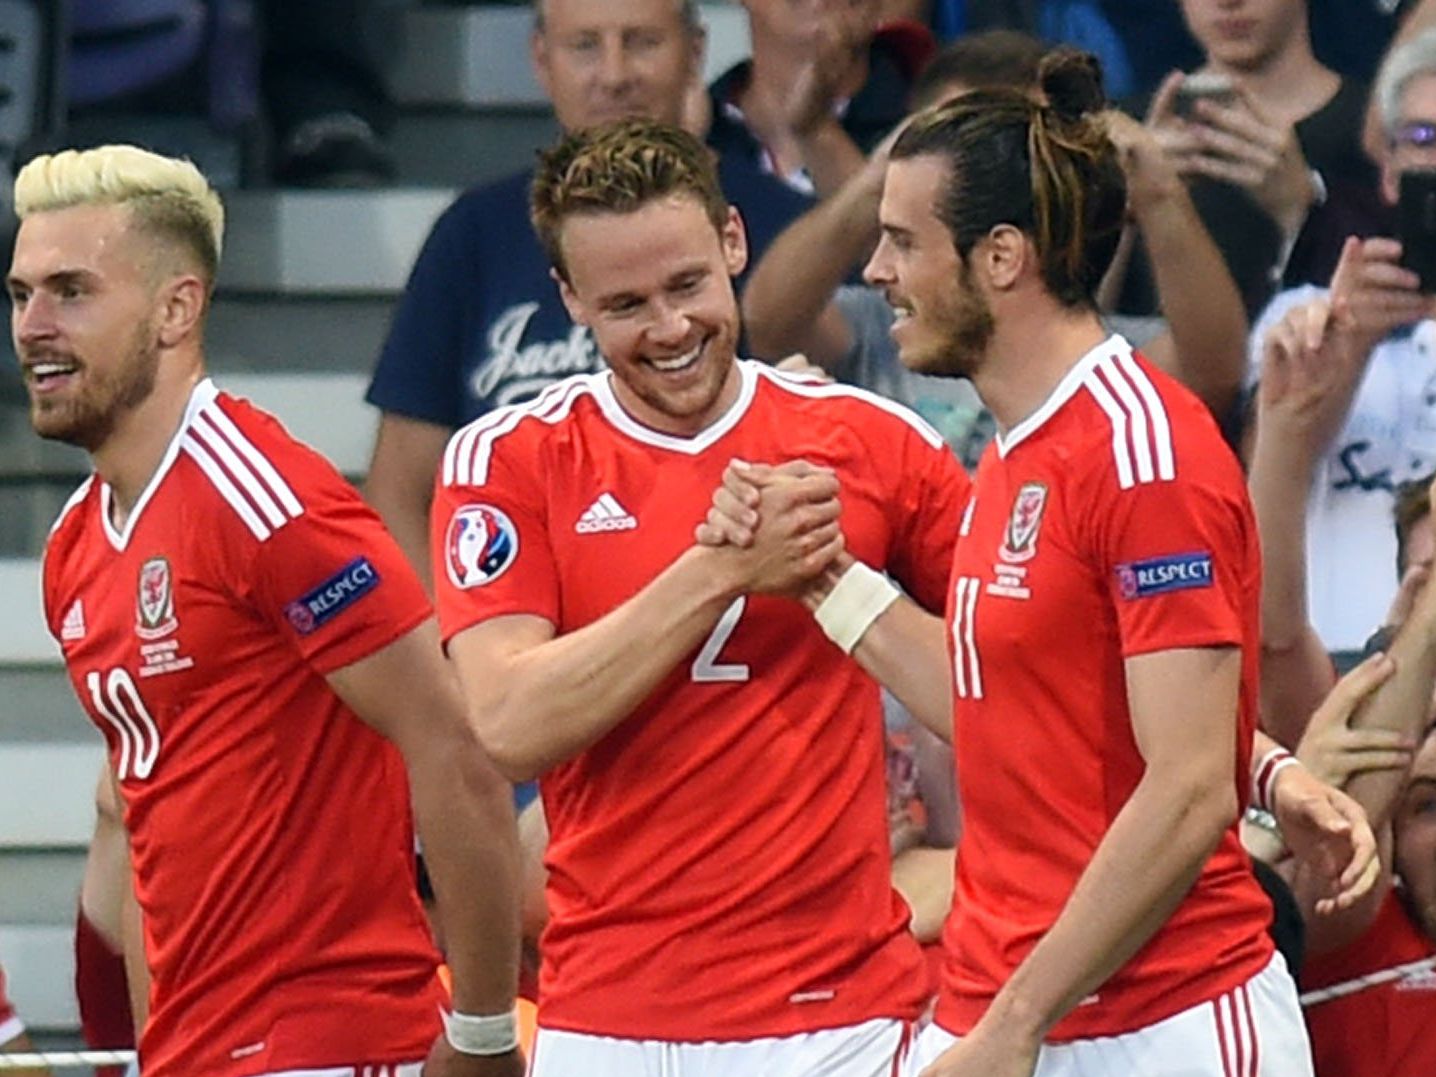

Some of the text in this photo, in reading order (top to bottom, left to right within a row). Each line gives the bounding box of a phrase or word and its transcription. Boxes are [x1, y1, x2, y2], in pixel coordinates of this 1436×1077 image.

[309, 562, 373, 616] RESPECT
[1138, 560, 1211, 587] RESPECT
[87, 667, 161, 780] 10
